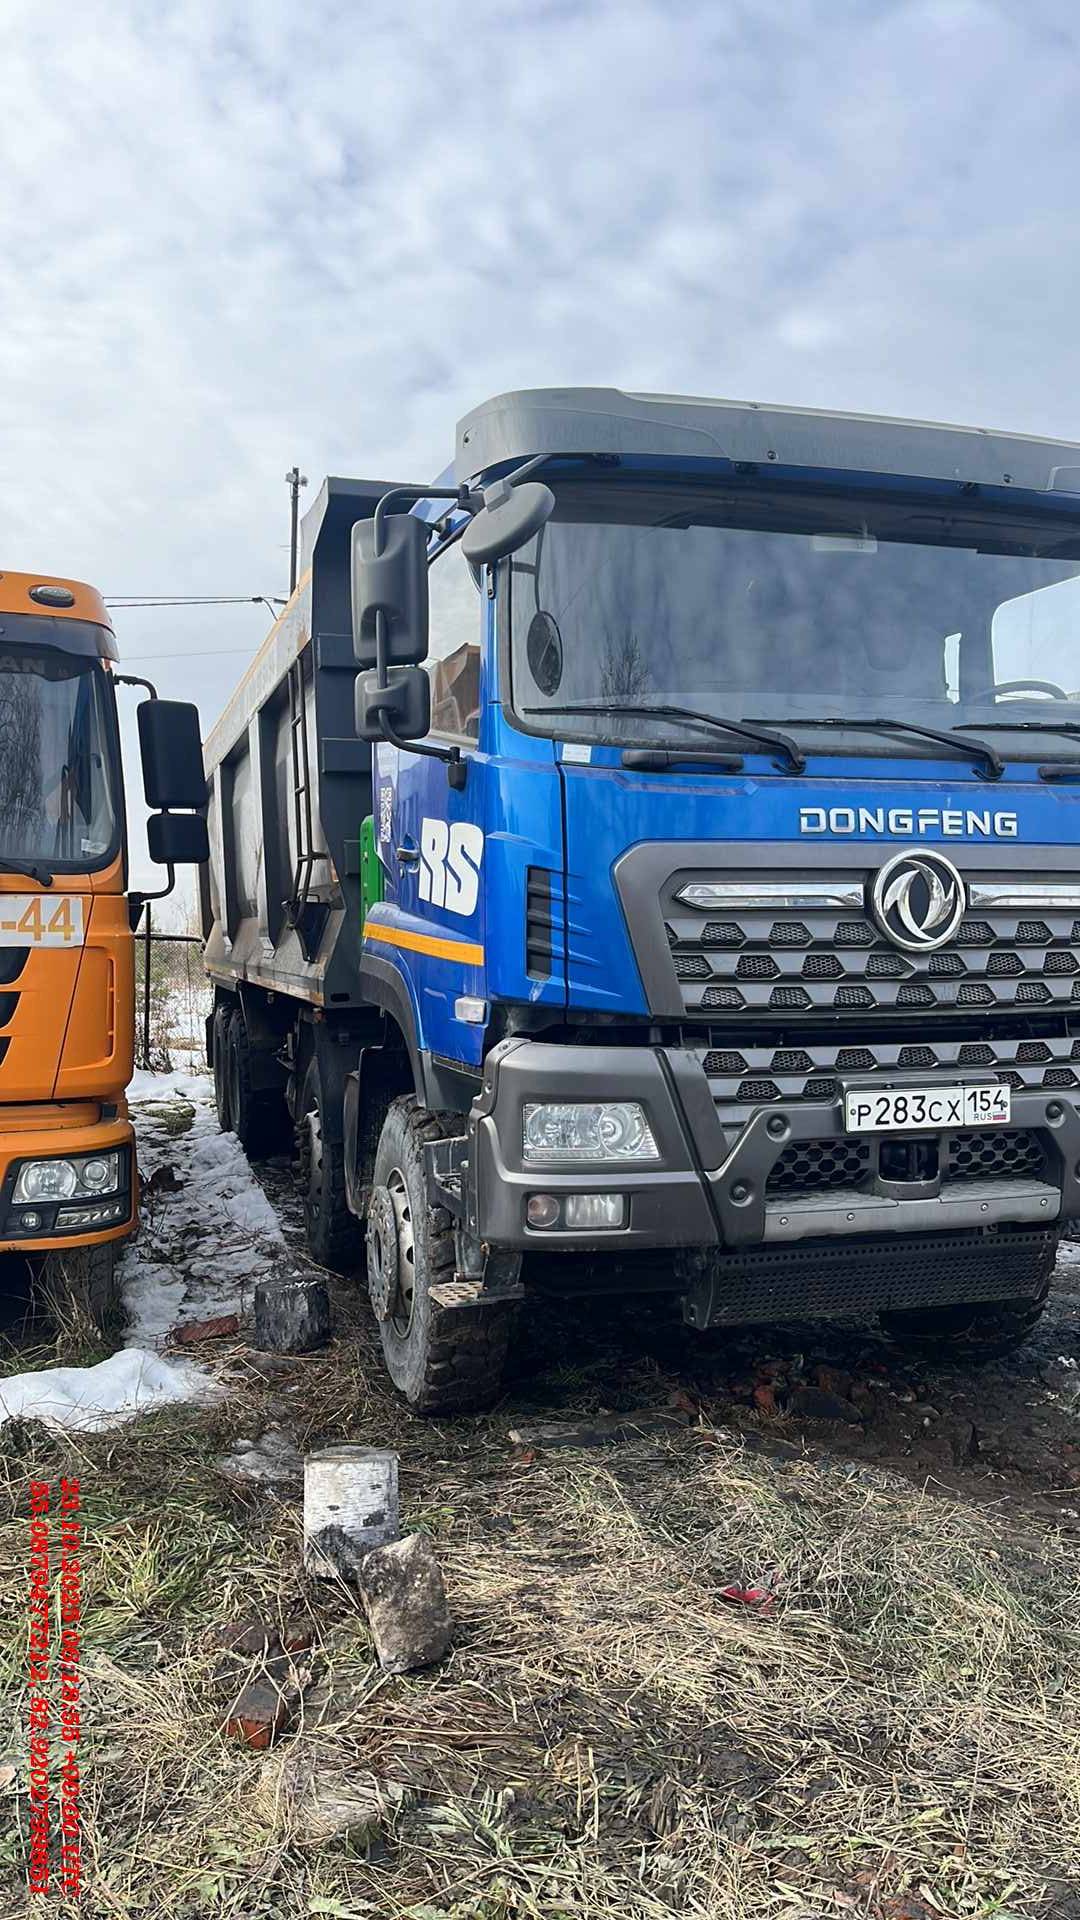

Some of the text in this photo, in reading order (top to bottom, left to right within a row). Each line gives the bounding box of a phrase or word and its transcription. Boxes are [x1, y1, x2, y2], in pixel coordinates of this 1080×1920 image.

[799, 807, 1018, 837] DONGFENG
[418, 817, 484, 916] RS
[973, 1110, 993, 1121] RUS
